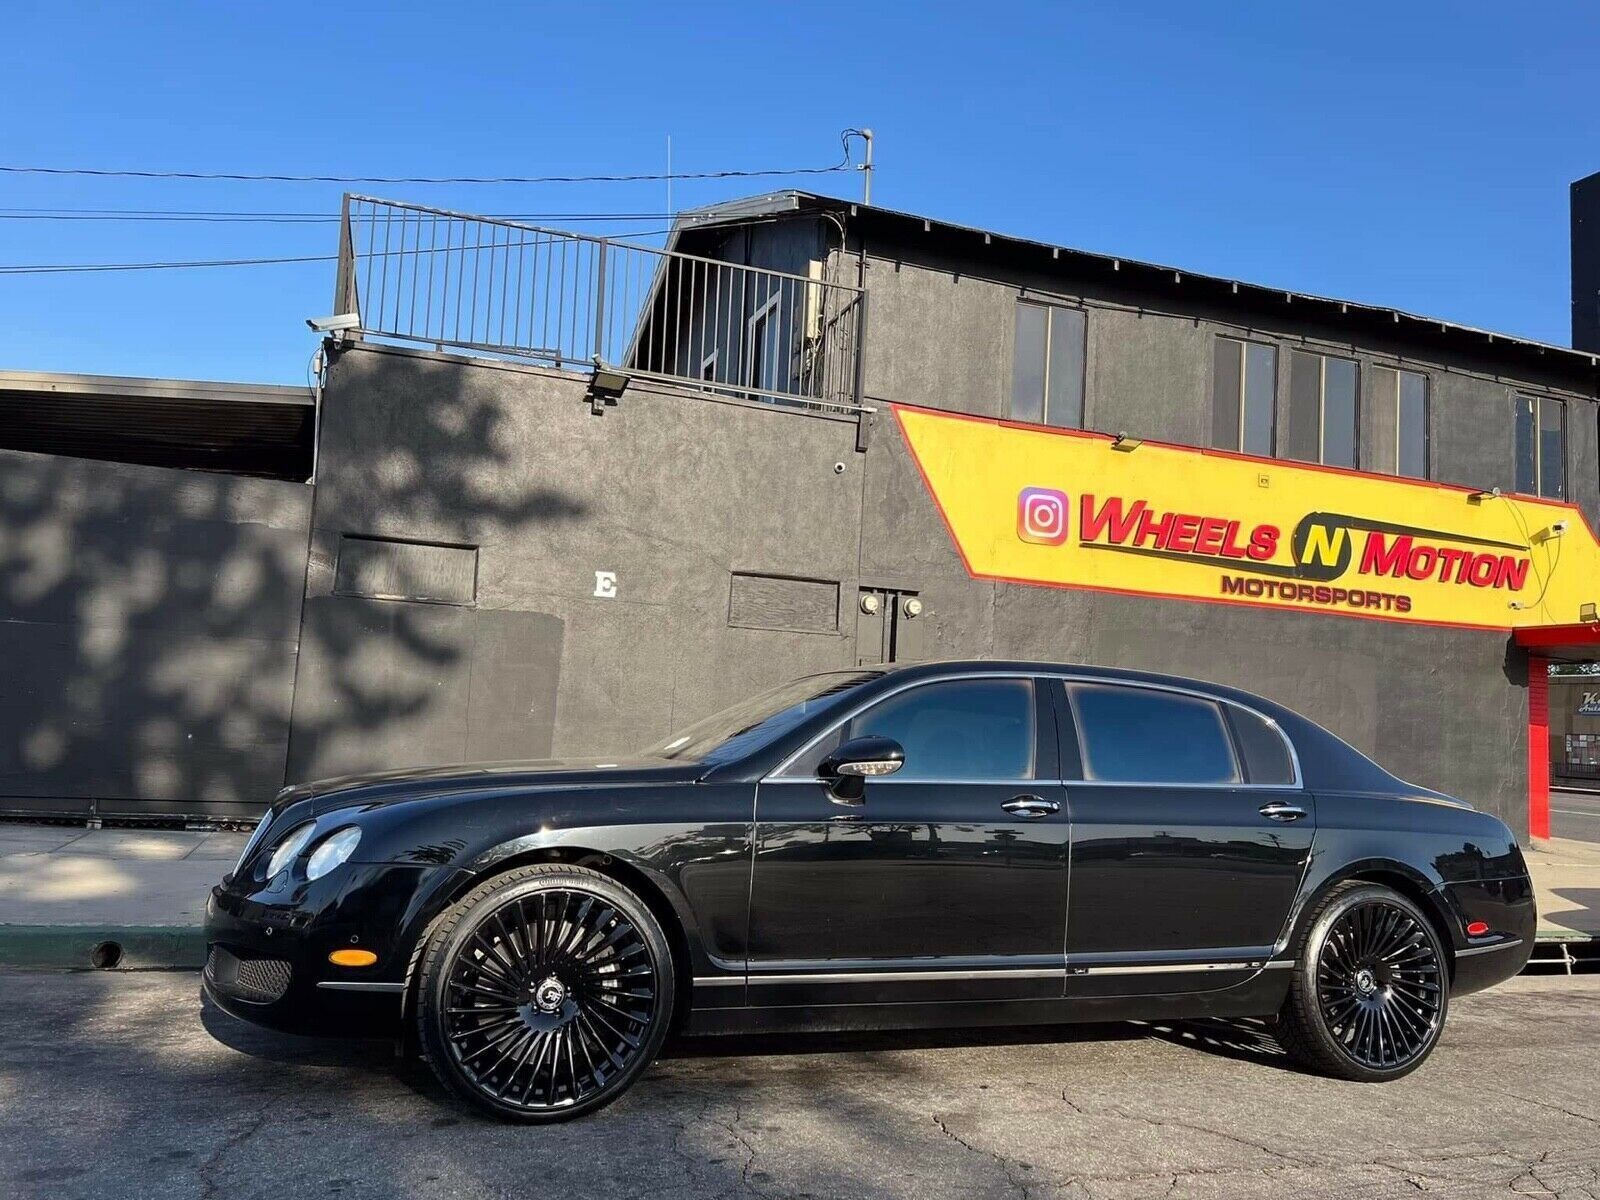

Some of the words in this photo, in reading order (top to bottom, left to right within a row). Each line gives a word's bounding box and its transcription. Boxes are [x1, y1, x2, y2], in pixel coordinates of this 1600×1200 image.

[1301, 524, 1346, 567] N
[593, 571, 617, 598] E
[1221, 575, 1412, 613] MOTORSPORTS
